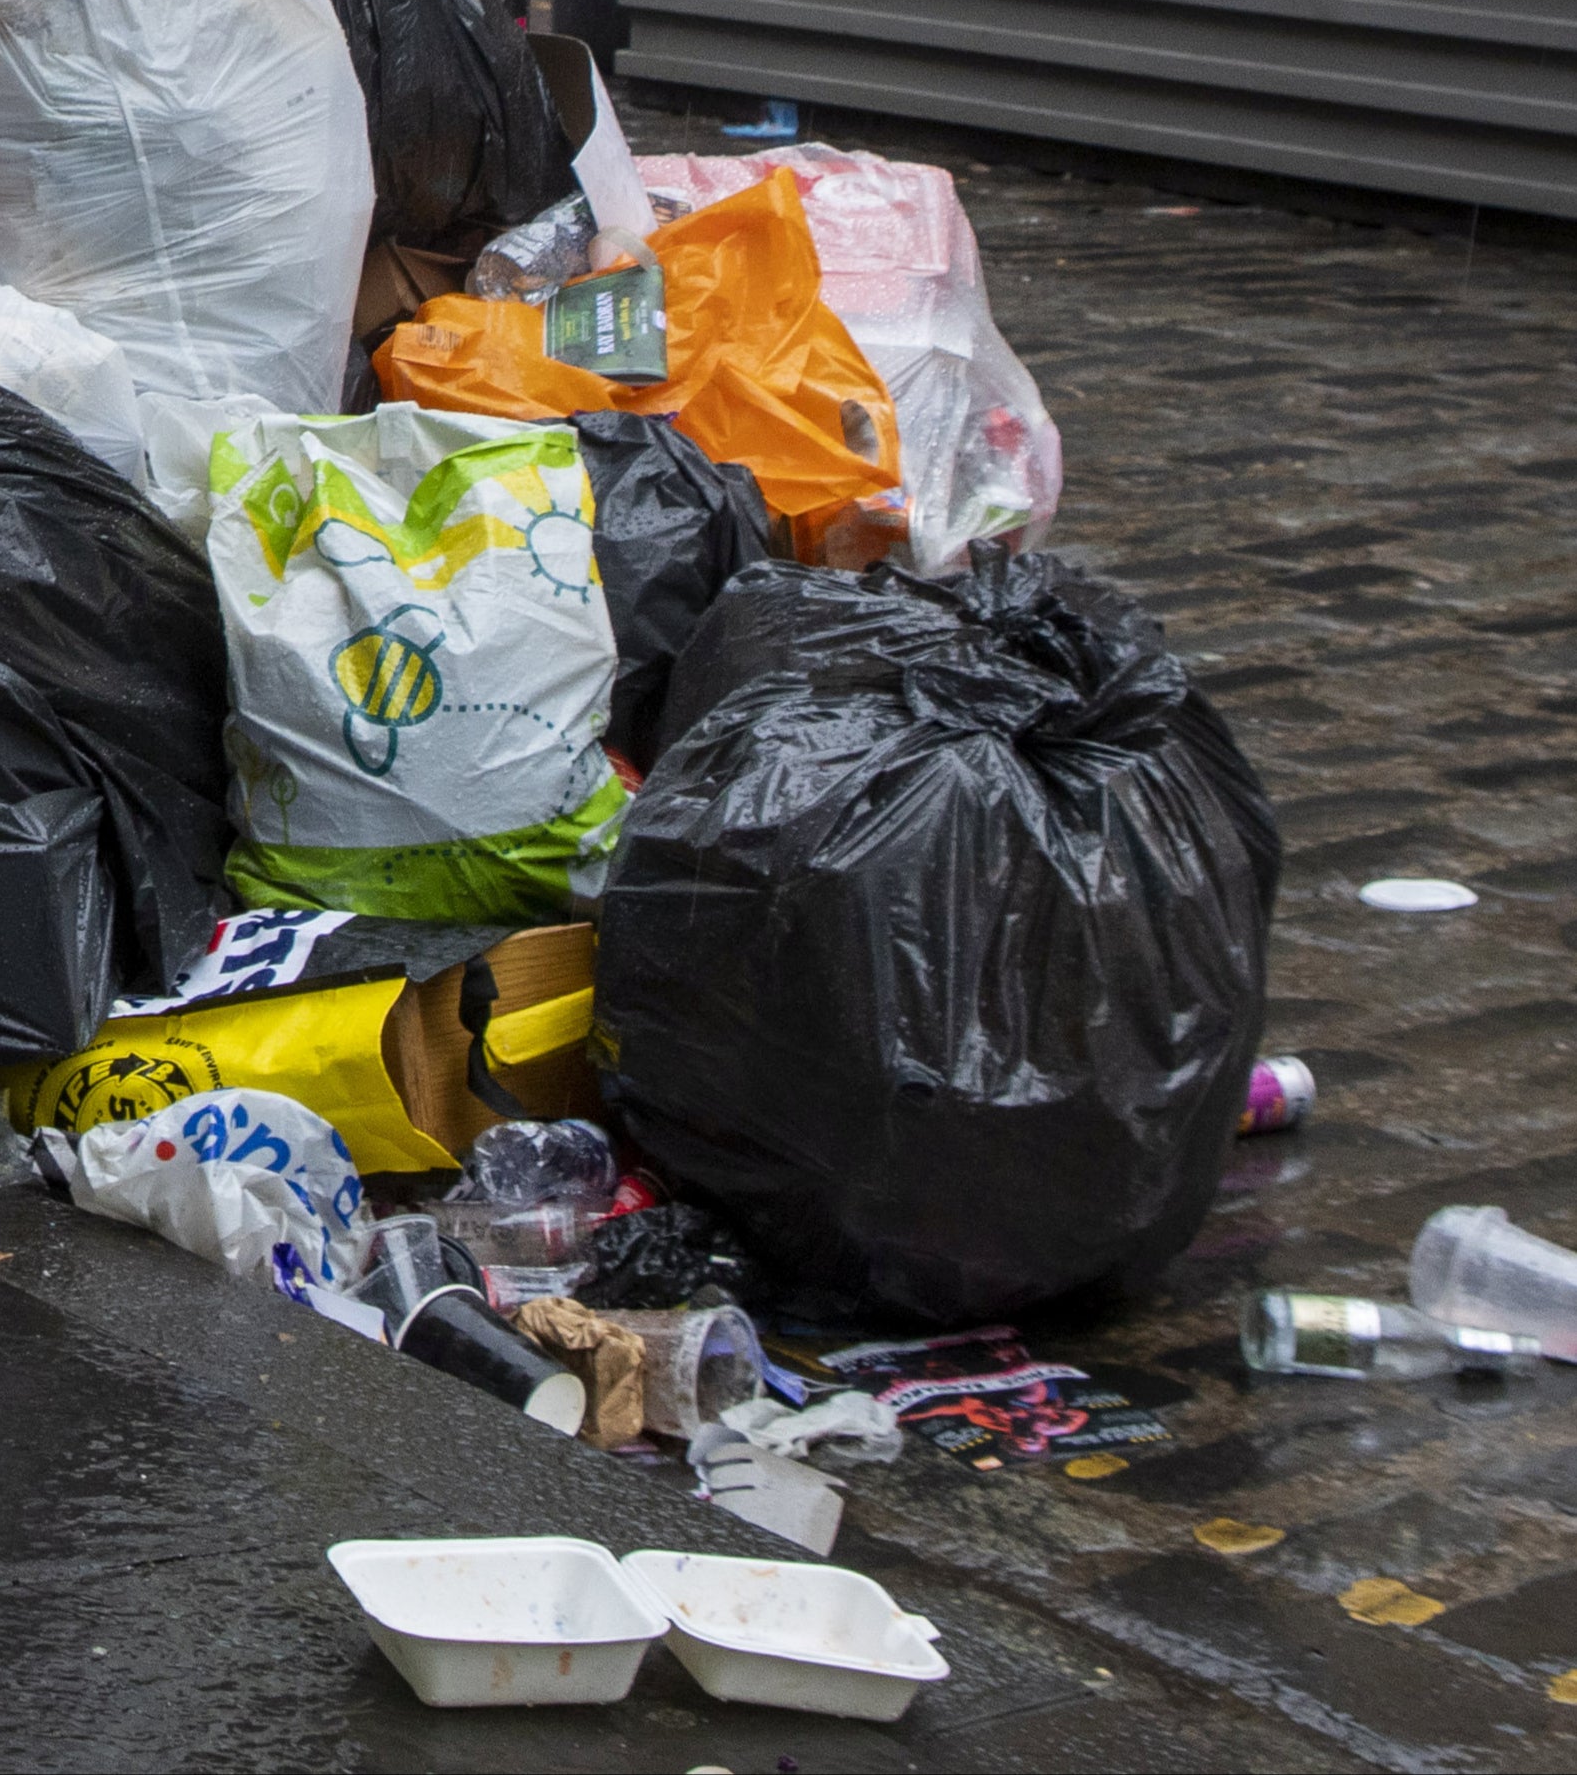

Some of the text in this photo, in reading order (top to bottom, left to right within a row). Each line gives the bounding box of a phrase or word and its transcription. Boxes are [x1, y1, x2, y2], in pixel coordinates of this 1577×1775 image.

[47, 1059, 113, 1131] IFE
[146, 1061, 191, 1103] BA
[200, 1050, 225, 1090] ENVIRO
